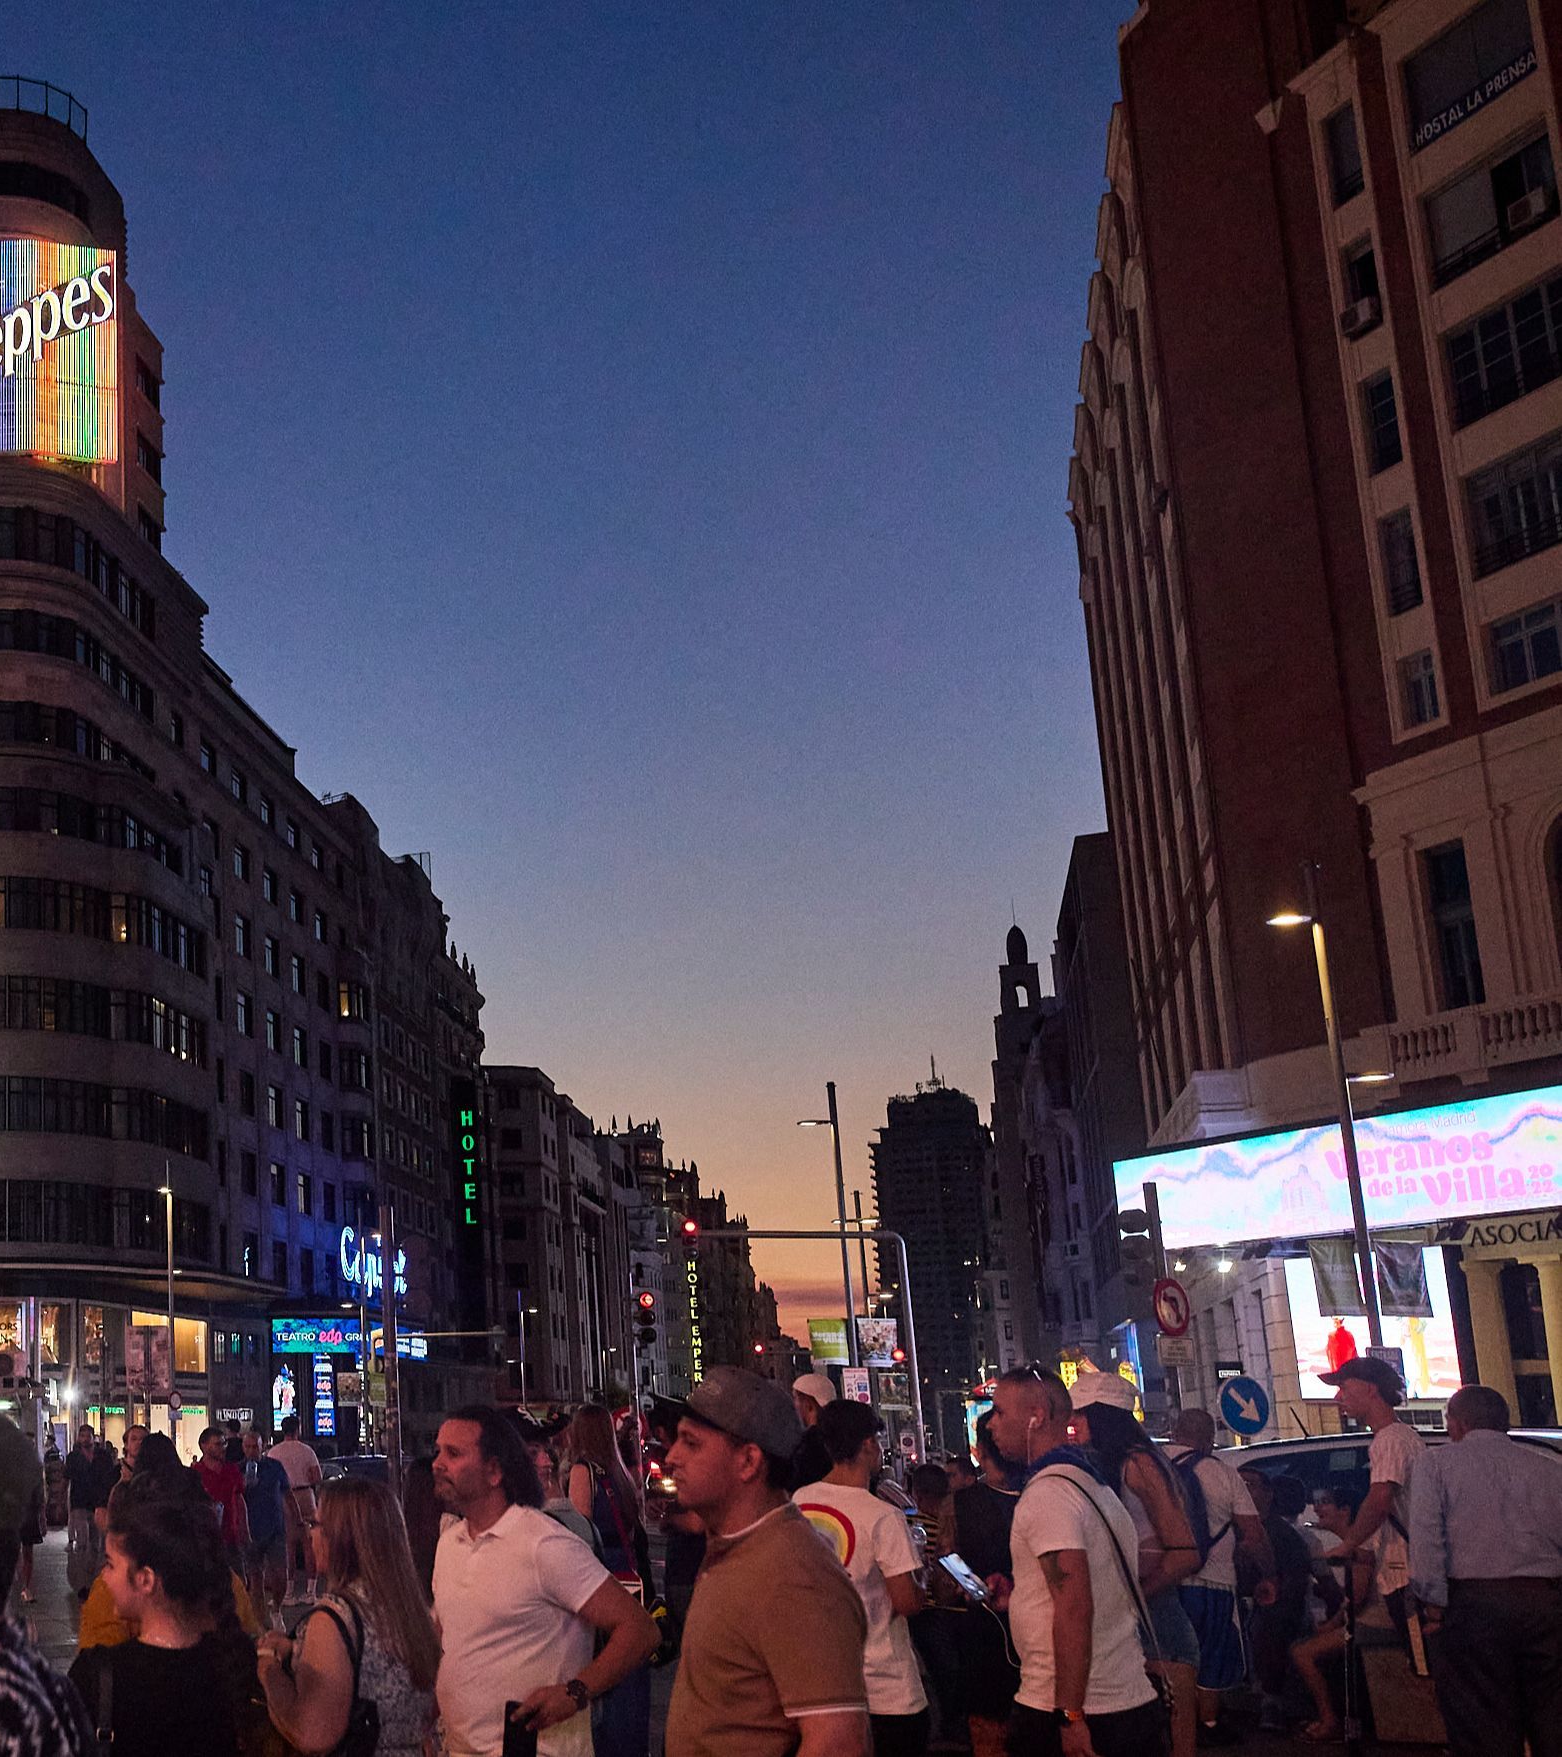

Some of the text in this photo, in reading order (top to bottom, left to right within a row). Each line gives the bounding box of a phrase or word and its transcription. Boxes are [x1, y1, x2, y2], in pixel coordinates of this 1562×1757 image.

[1415, 51, 1537, 146] HOSTAL LA PRENSA
[1430, 1110, 1476, 1128] Madrid
[460, 1110, 478, 1225] HOTEL
[1527, 1163, 1555, 1180] 20
[1367, 1178, 1393, 1198] de
[1395, 1175, 1418, 1194] la
[1470, 1218, 1562, 1247] ASOCIA
[687, 1260, 703, 1383] HOTEL EMPER
[276, 1332, 316, 1341] TEATRO
[319, 1328, 343, 1346] edp
